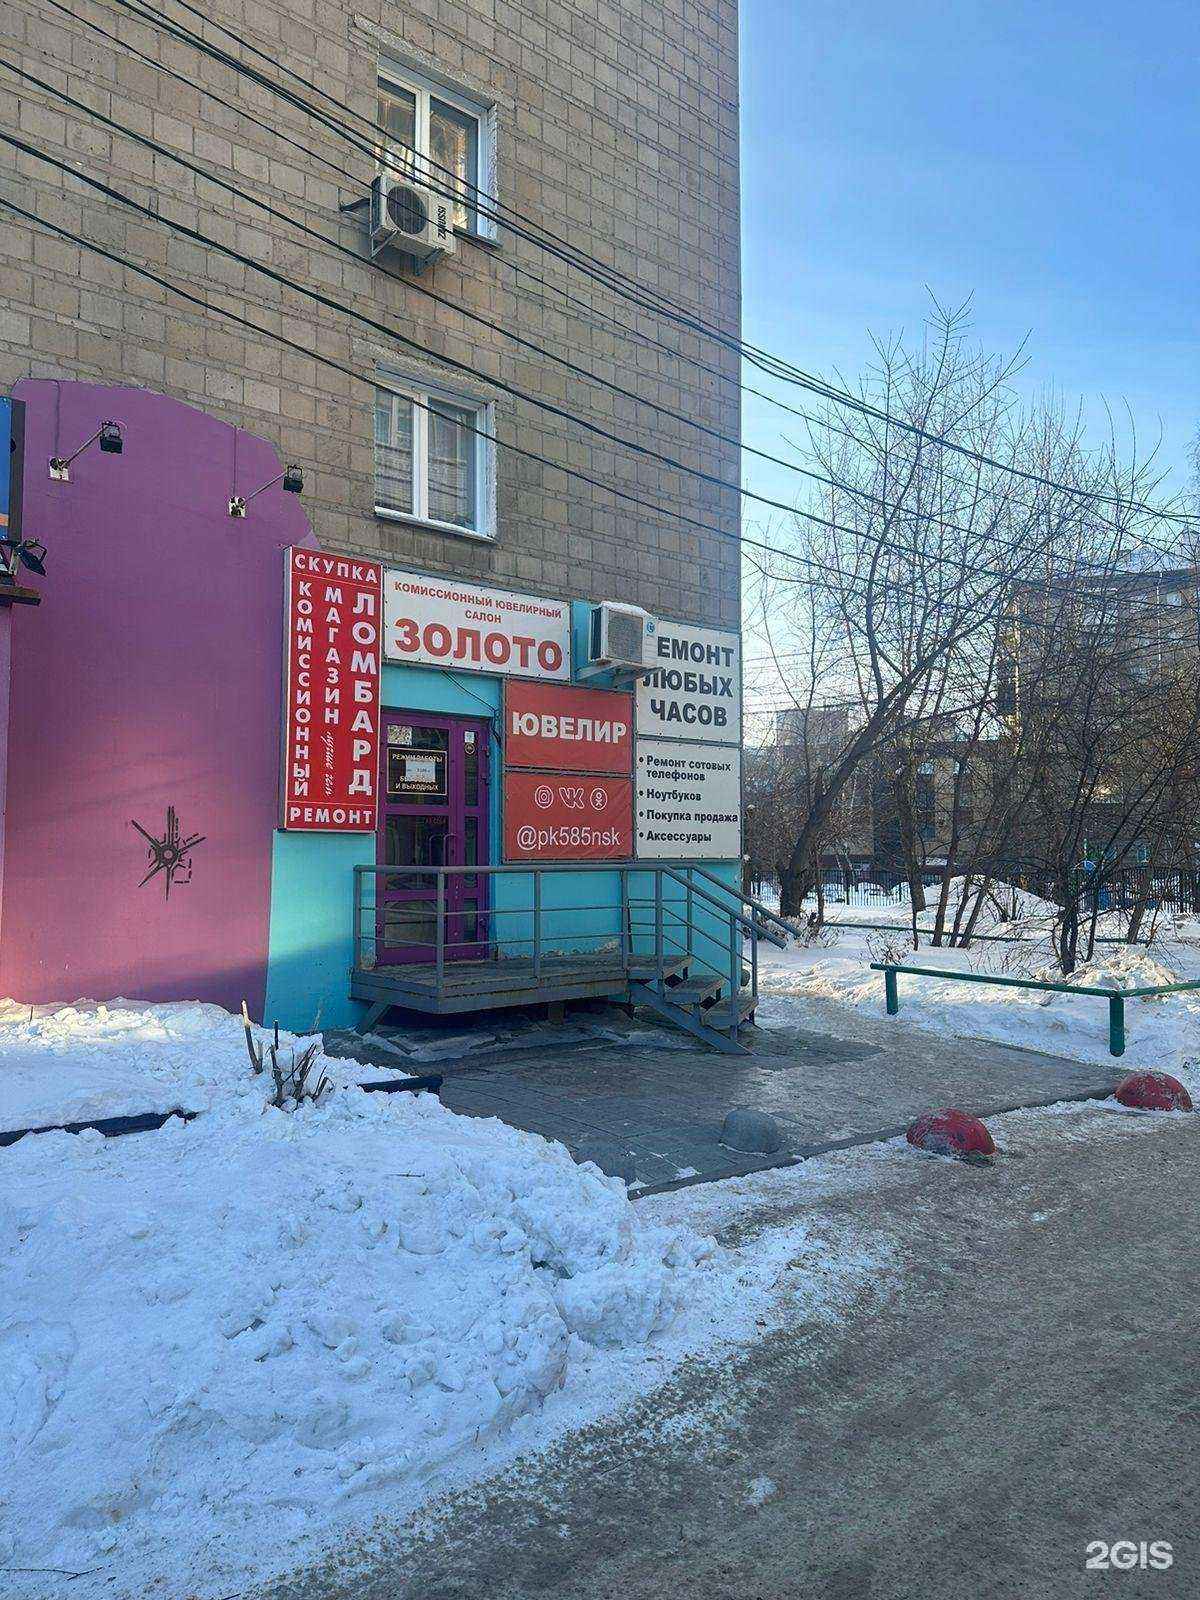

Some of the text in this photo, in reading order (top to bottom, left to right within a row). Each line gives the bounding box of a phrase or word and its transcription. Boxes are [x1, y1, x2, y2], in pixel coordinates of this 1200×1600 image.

[294, 554, 378, 584] СКУПКА
[394, 581, 562, 619] КОМИССИОННЫЙ ЮВЕЛИРНЫЙ
[464, 609, 502, 624] САЛОН
[324, 586, 343, 725] МАГАЗИН
[394, 618, 563, 671] ЗОЛОТО
[657, 636, 735, 668] ЕМОНТ
[293, 581, 314, 796] КОМИССИОННЫЙ
[348, 592, 377, 796] ЛОМБАРД
[650, 698, 728, 727] ЧАСОВ
[512, 711, 627, 744] ЮВЕЛИР
[646, 755, 732, 772] Ремонт сотовых
[646, 770, 706, 782] телефонов
[646, 788, 702, 802] Ноутбуков
[290, 807, 372, 824] РЕМОНТ
[646, 809, 739, 823] Покупка продажа
[517, 825, 621, 851] @pk585nsk
[646, 830, 712, 843] Аксессуары
